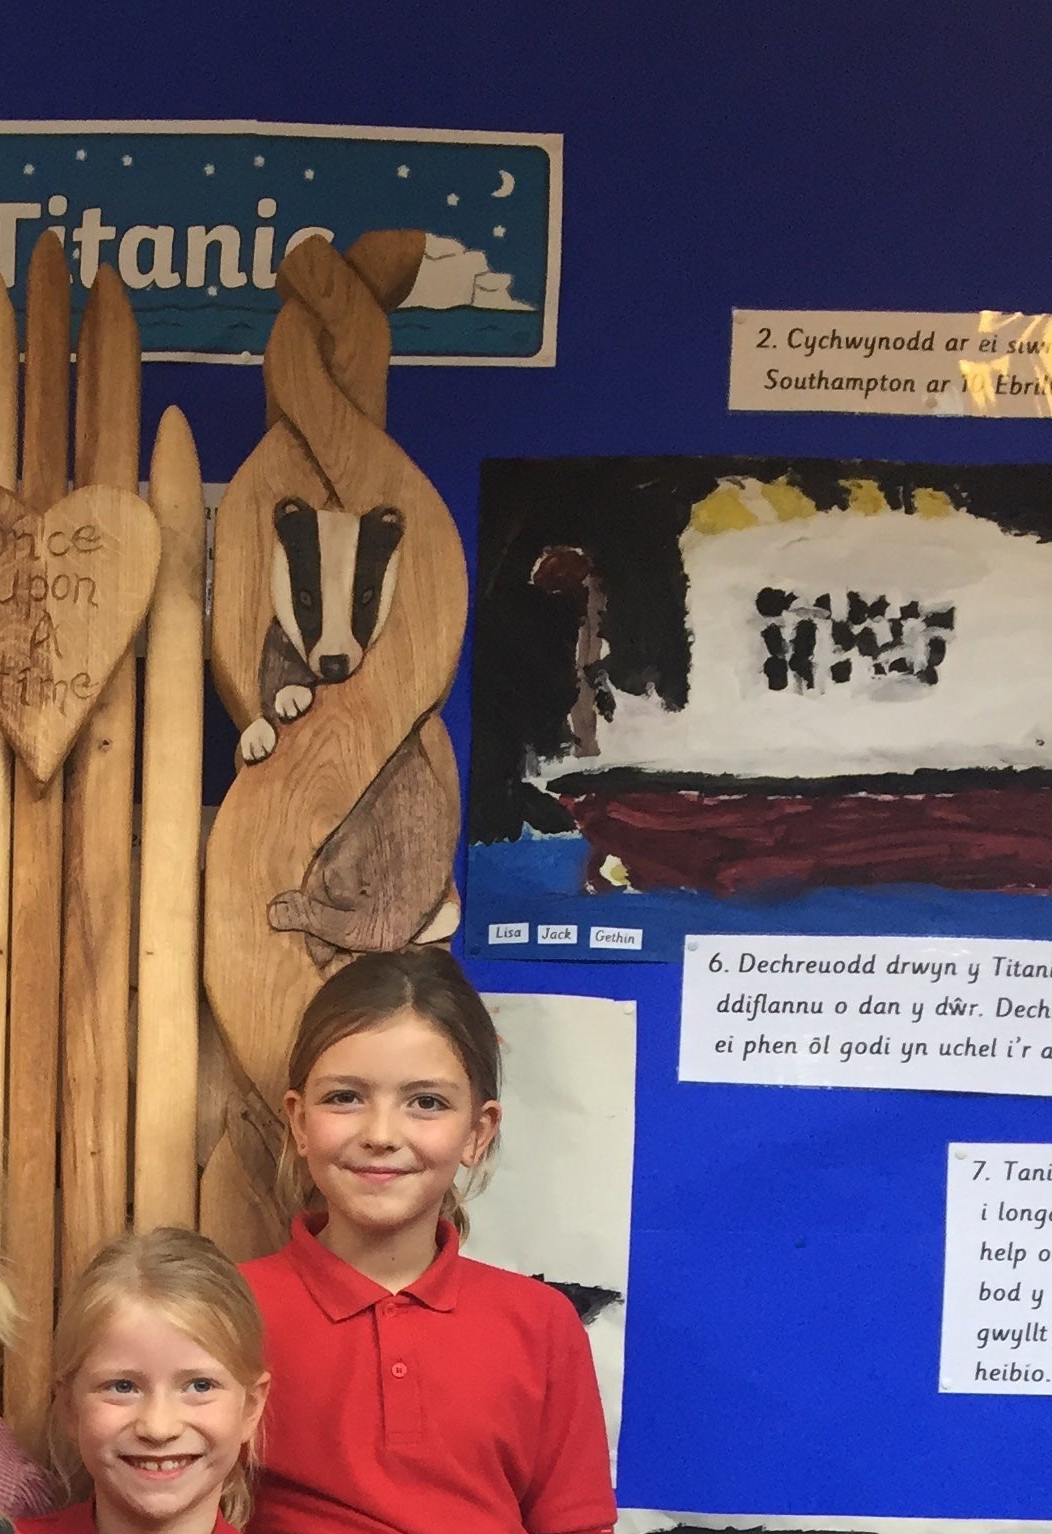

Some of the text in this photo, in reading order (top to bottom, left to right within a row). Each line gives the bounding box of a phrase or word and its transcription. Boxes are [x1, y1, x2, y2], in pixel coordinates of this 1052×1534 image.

[755, 327, 778, 350] 2.
[786, 327, 936, 359] Cychwynodd
[944, 337, 971, 353] ar
[978, 334, 998, 354] ei
[763, 368, 916, 400] Southampton
[925, 378, 952, 394] ar
[496, 926, 635, 945] Lisa Jack Gethin
[708, 951, 730, 973] 6.
[738, 952, 877, 975] Dechreuodd
[885, 953, 958, 984] drwyn
[967, 962, 981, 985] y
[716, 992, 824, 1022] ddiflannu
[834, 1000, 848, 1015] o
[858, 994, 901, 1016] dan
[911, 1002, 925, 1024] y
[934, 995, 984, 1018] dŵr.
[714, 1035, 734, 1054] ei
[742, 1033, 798, 1062] phen
[808, 1034, 831, 1055] ôl
[839, 1034, 891, 1064] godi
[900, 1042, 929, 1064] yn
[938, 1036, 998, 1058] uchel
[1006, 1035, 1032, 1059] i'r
[972, 1160, 991, 1182] 7.
[980, 1202, 988, 1222] i
[979, 1240, 1052, 1270] help o
[978, 1280, 1044, 1311] bod y
[976, 1321, 1049, 1350] gwyllt
[974, 1360, 1051, 1383] heibio.
